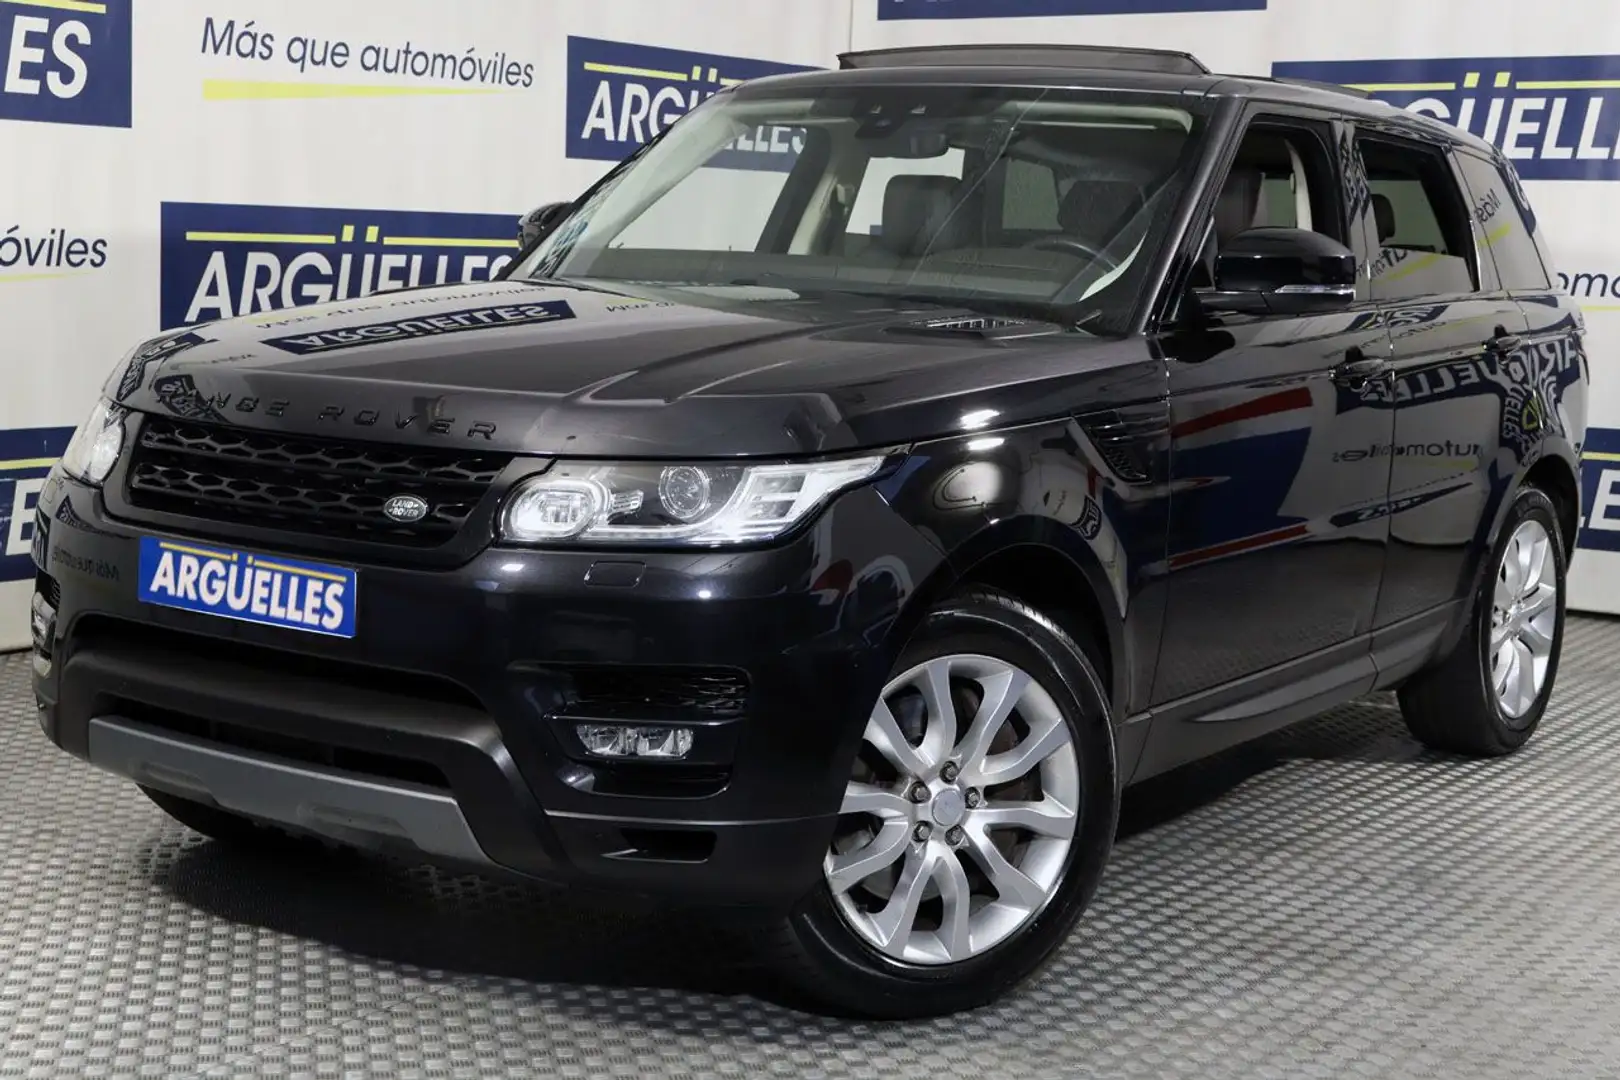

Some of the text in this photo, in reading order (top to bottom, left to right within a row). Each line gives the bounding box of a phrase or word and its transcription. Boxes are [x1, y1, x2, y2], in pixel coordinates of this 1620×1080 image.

[4, 15, 91, 99] ES
[201, 17, 534, 88] Más que automóviles
[317, 404, 497, 440] ROVER
[150, 551, 344, 630] ARGÜELLES
